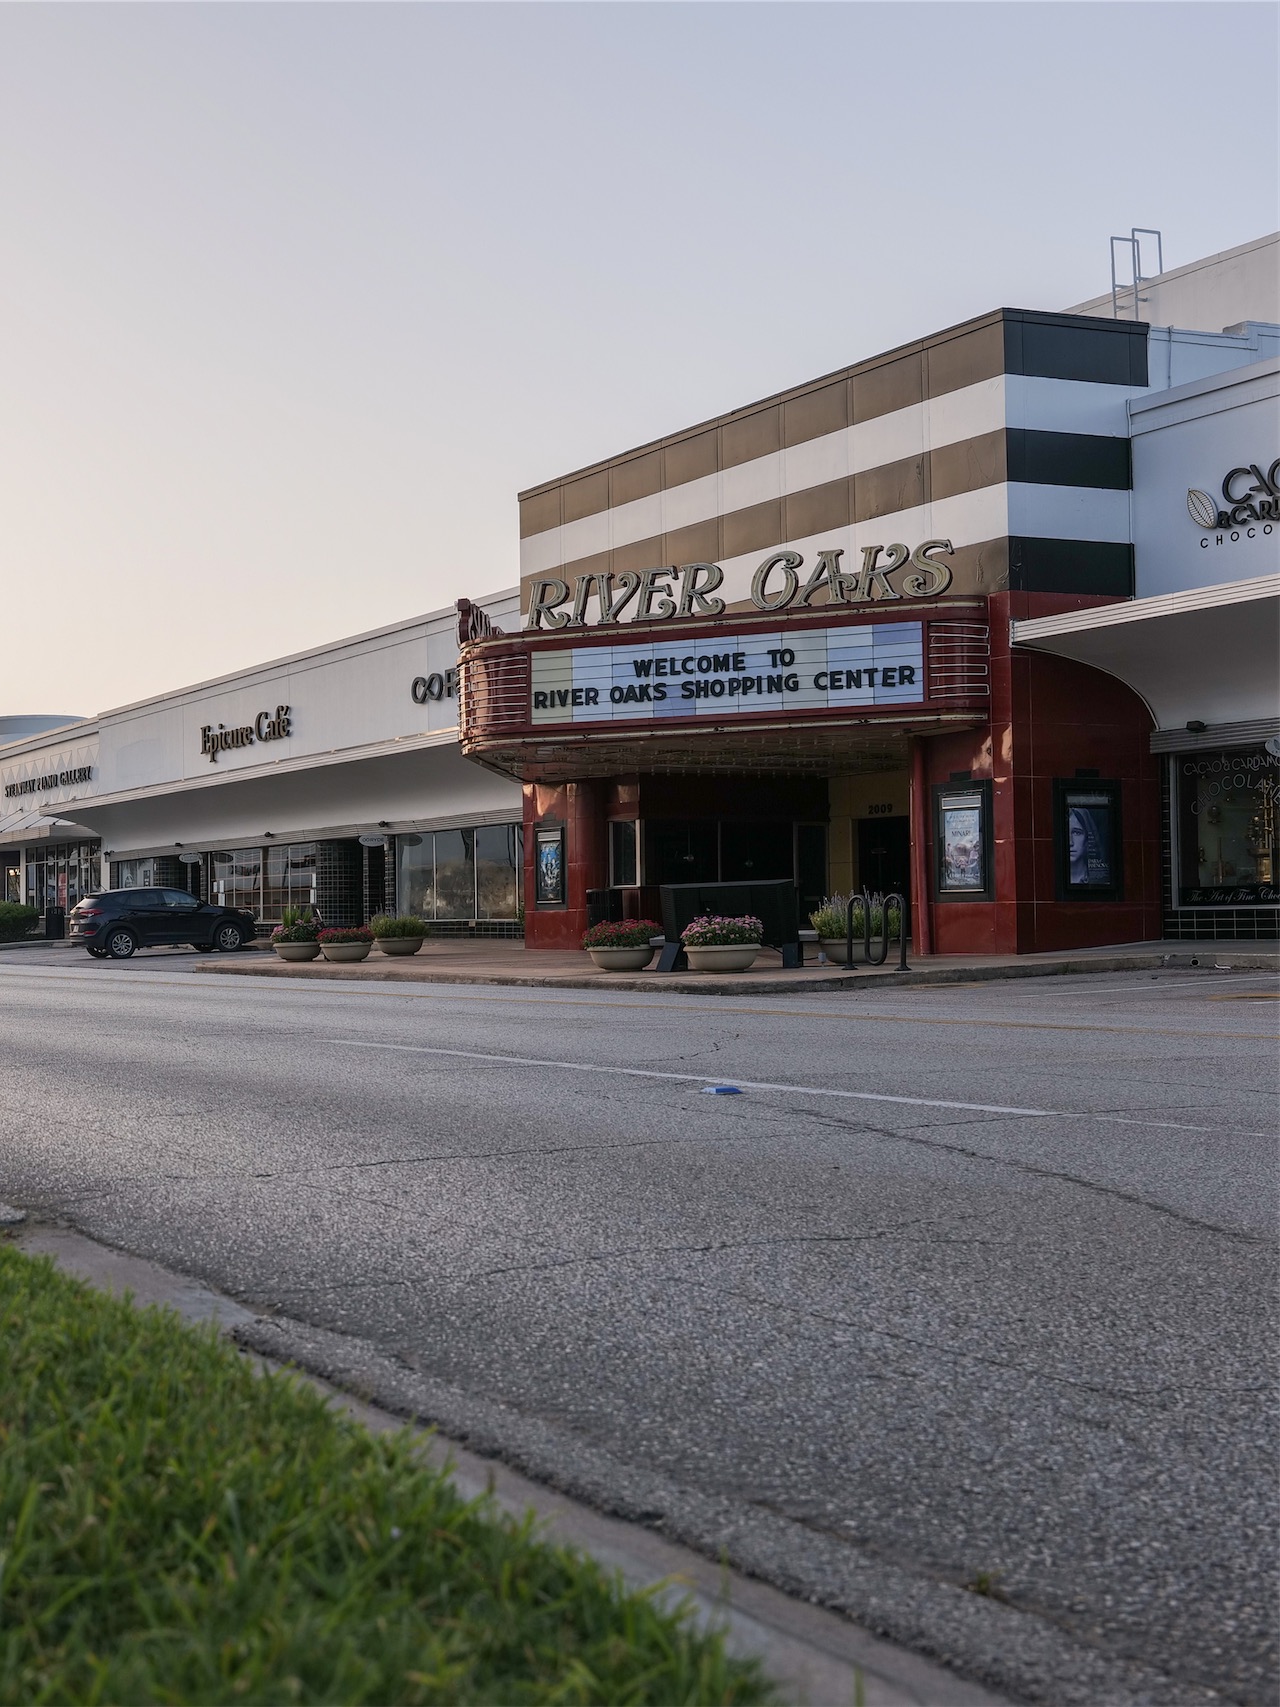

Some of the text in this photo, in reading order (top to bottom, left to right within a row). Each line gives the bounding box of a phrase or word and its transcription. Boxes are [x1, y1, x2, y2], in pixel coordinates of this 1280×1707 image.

[522, 562, 726, 631] RIVER
[750, 539, 955, 611] OAKS
[633, 648, 795, 678] WELCOME TO
[534, 665, 915, 709] RIVER OAKS SHOPPING CENTER
[200, 705, 291, 763] Epicure Café
[60, 765, 92, 786] GALLERY
[1183, 760, 1222, 777] CACAO
[867, 803, 893, 815] 2009
